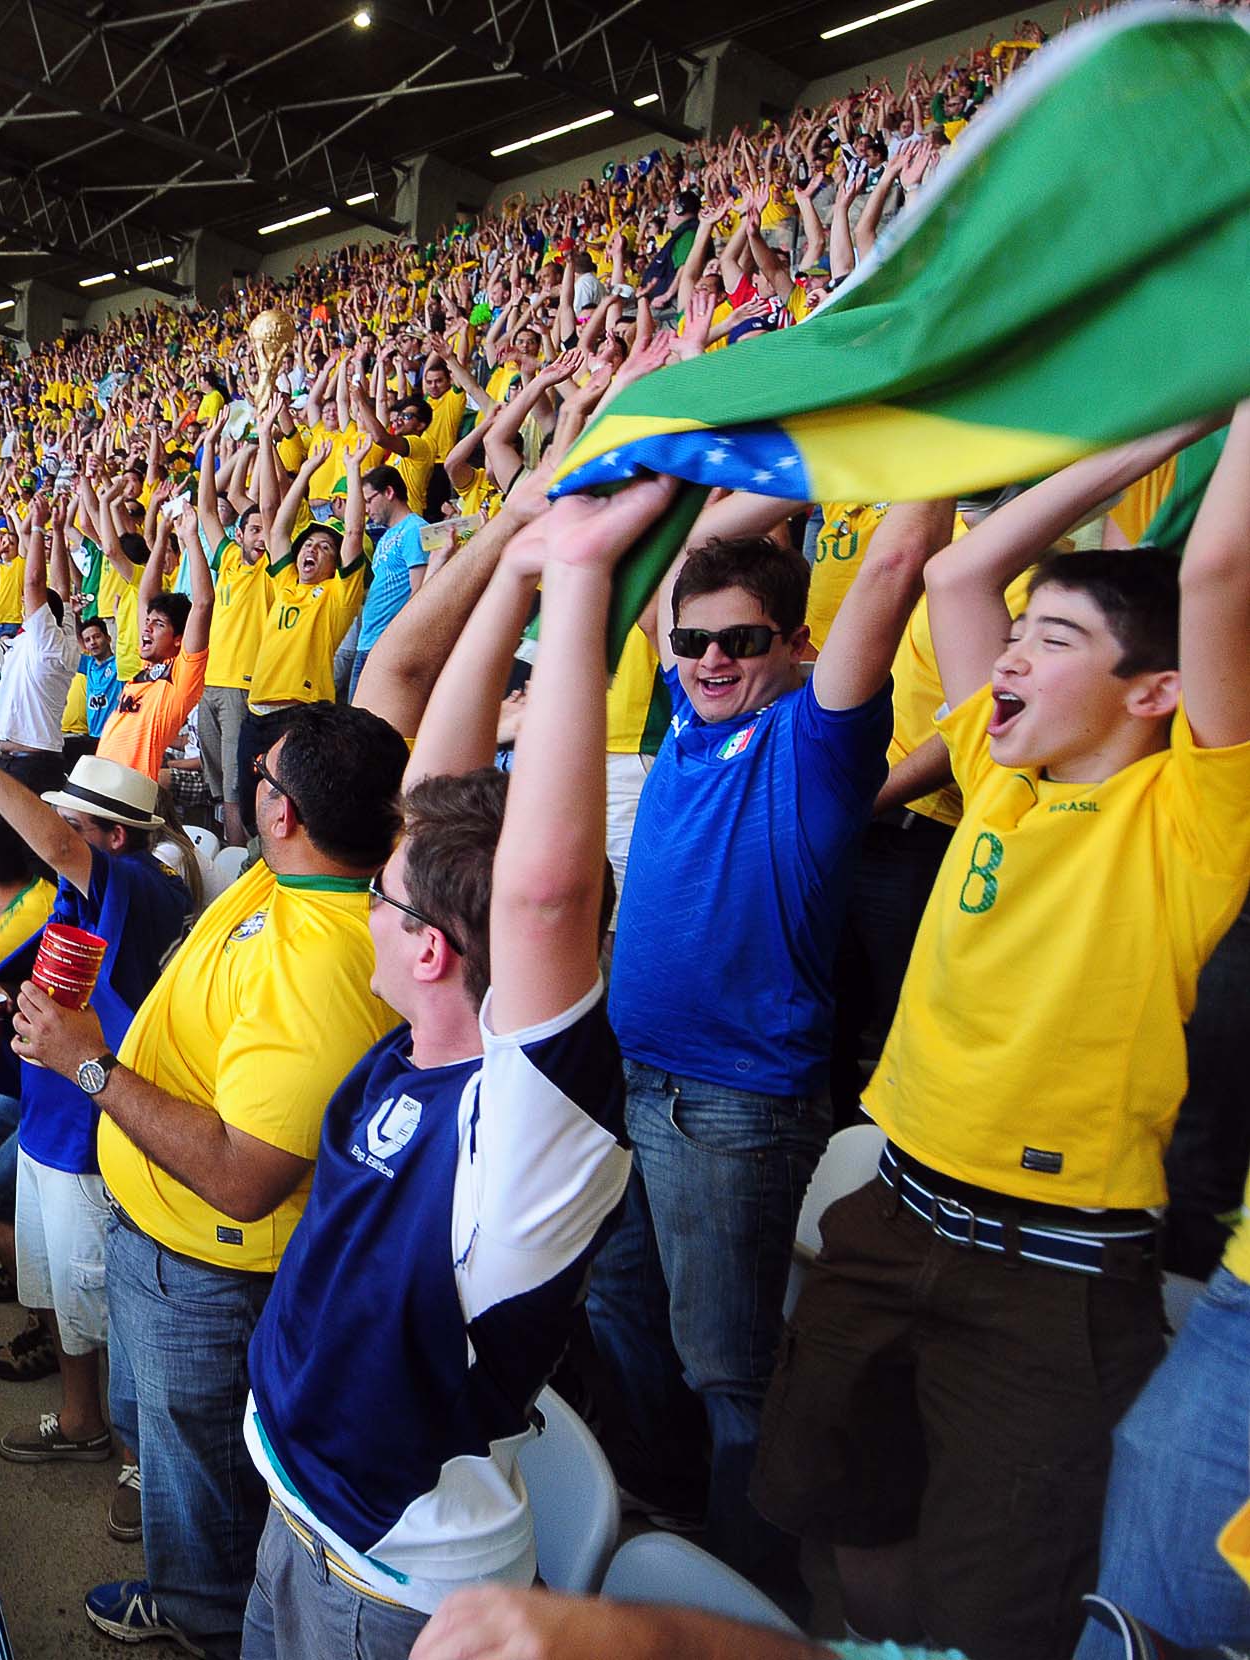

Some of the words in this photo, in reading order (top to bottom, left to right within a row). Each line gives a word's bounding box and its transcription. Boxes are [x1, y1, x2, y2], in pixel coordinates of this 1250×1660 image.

[278, 605, 301, 630] 10
[1048, 801, 1102, 813] BRASIL
[958, 831, 1004, 915] 8
